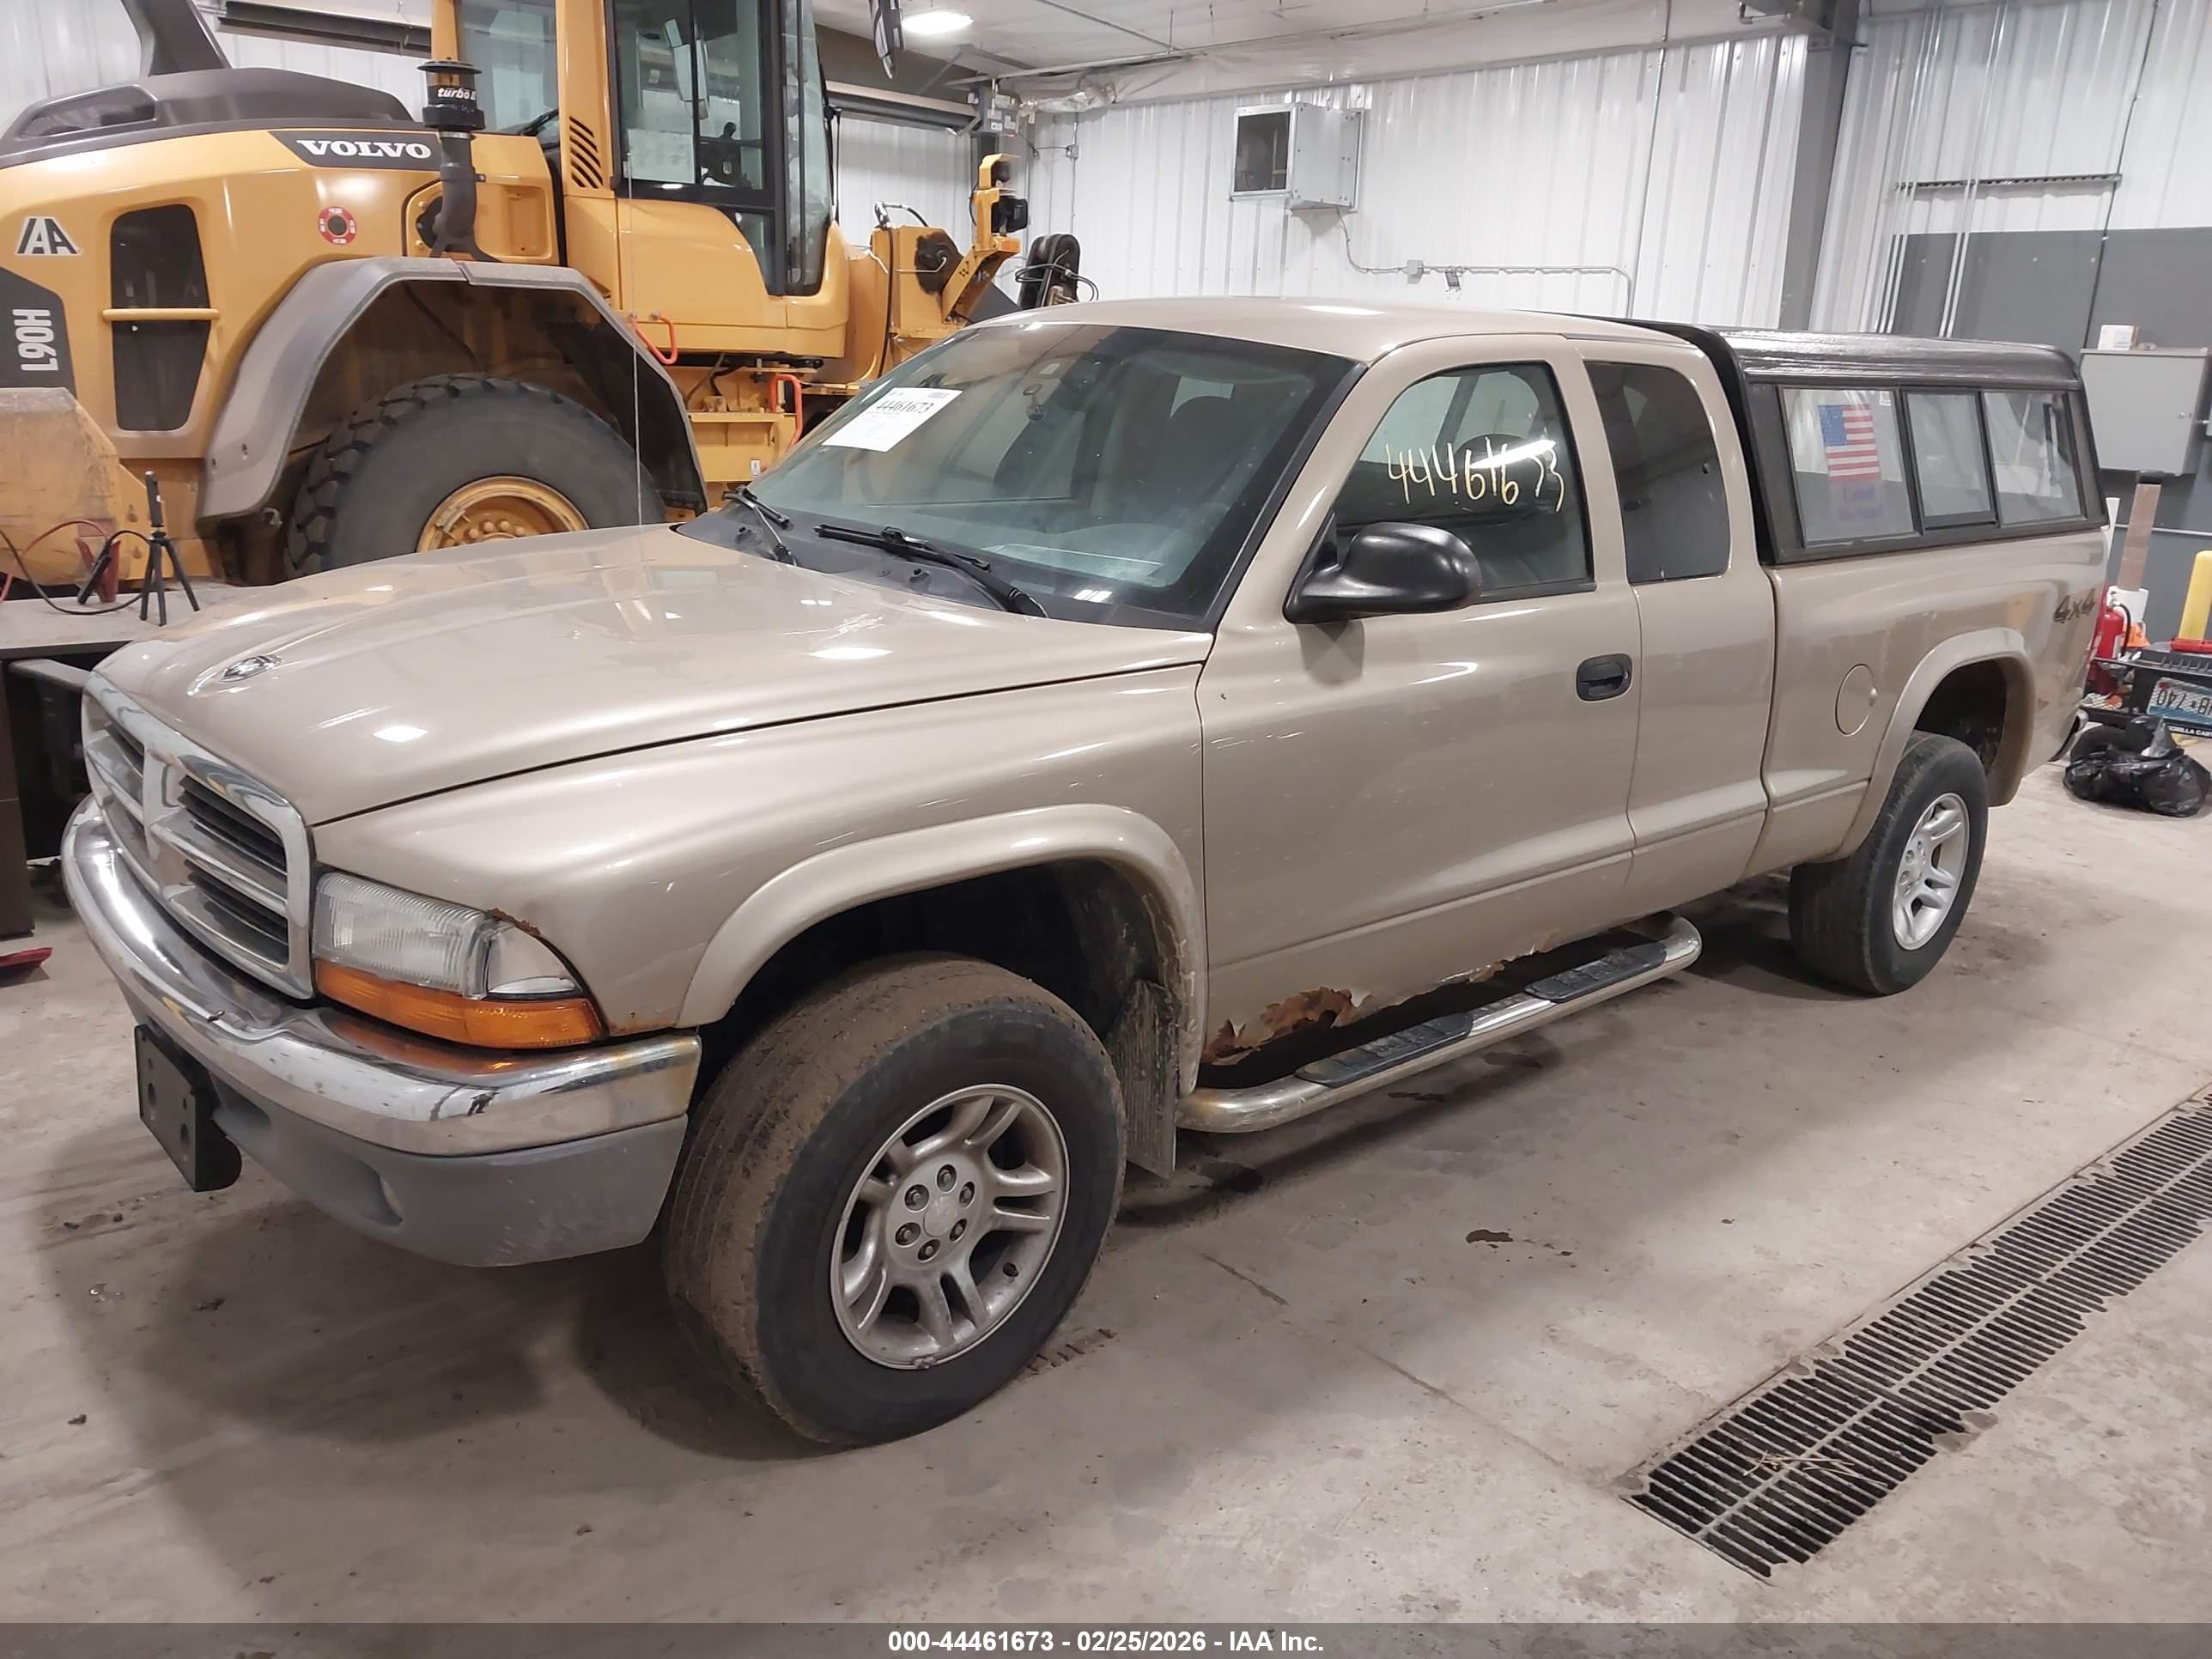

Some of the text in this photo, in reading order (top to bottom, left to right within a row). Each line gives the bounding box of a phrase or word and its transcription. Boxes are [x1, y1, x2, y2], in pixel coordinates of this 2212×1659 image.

[438, 88, 470, 100] turbo
[296, 140, 431, 159] VOLVO
[16, 217, 79, 255] IAA
[12, 308, 58, 371] L90H
[1386, 434, 1565, 513] 44461673
